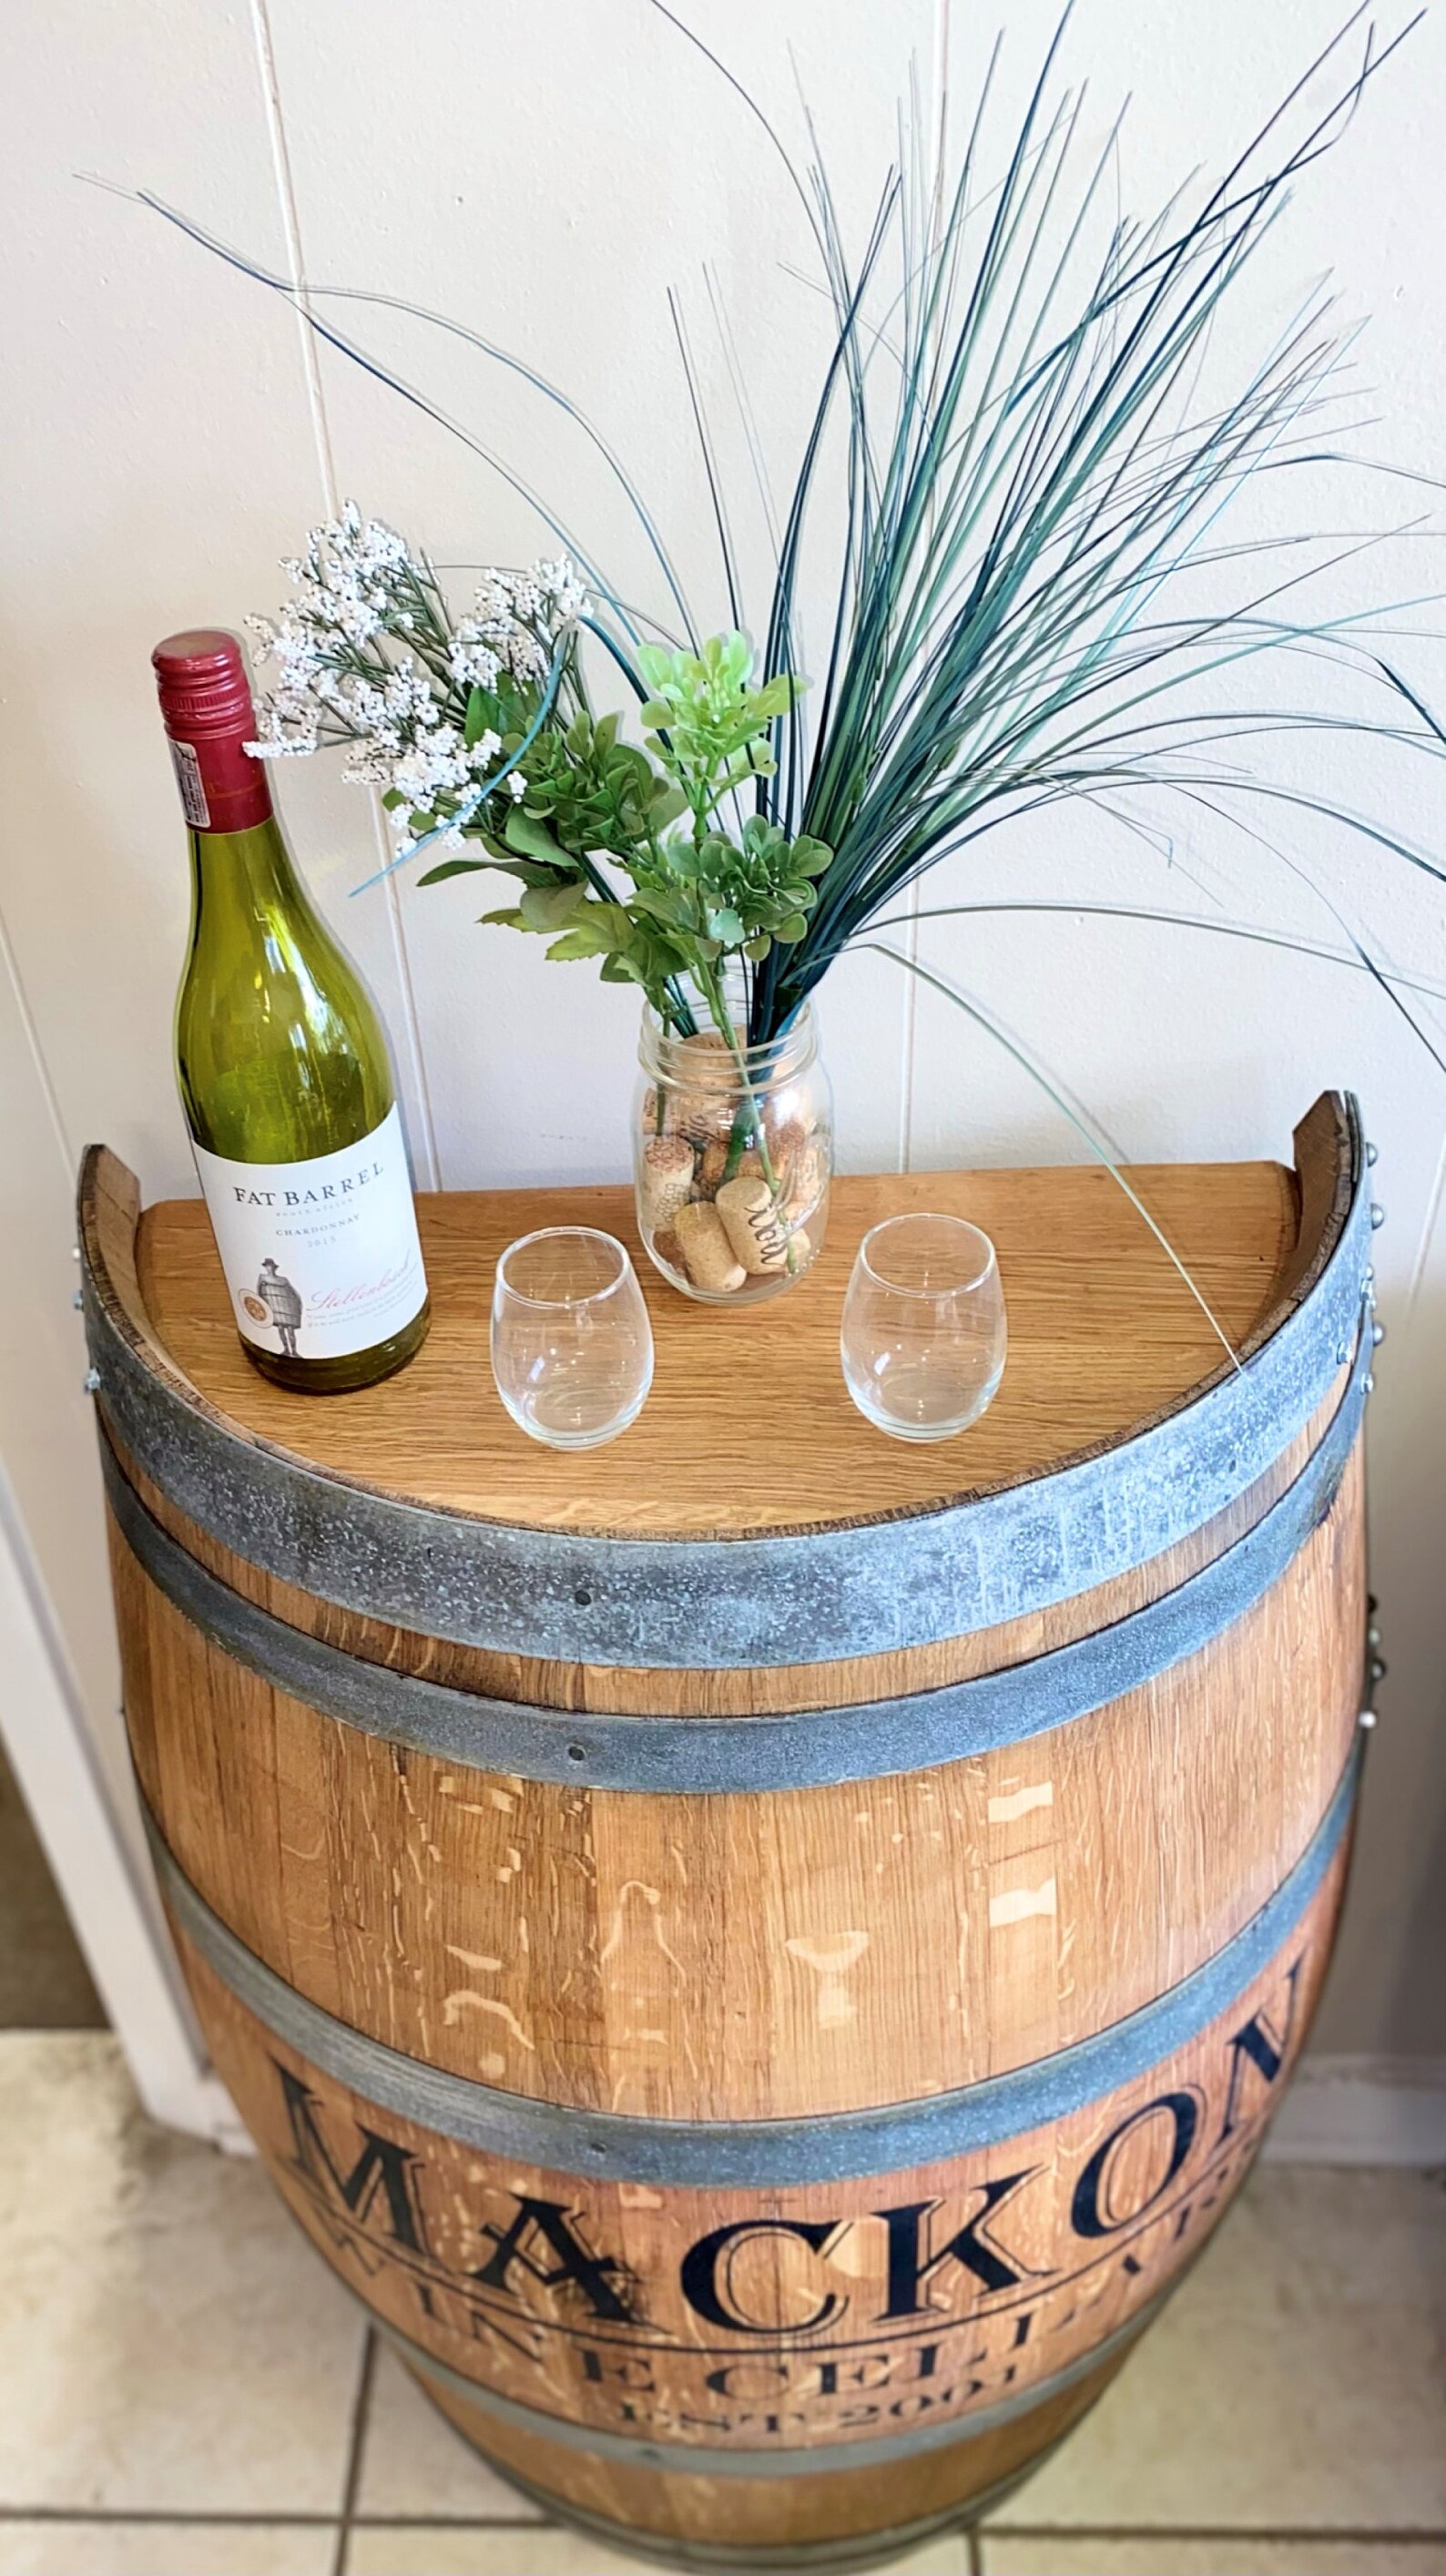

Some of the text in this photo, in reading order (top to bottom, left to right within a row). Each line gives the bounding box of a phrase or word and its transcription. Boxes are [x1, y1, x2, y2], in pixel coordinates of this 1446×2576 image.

[233, 1160, 384, 1207] FAT BARREL
[275, 1213, 360, 1237] CHARDONNAY
[263, 1943, 1309, 2337] MACKON
[308, 2194, 657, 2395] WINE
